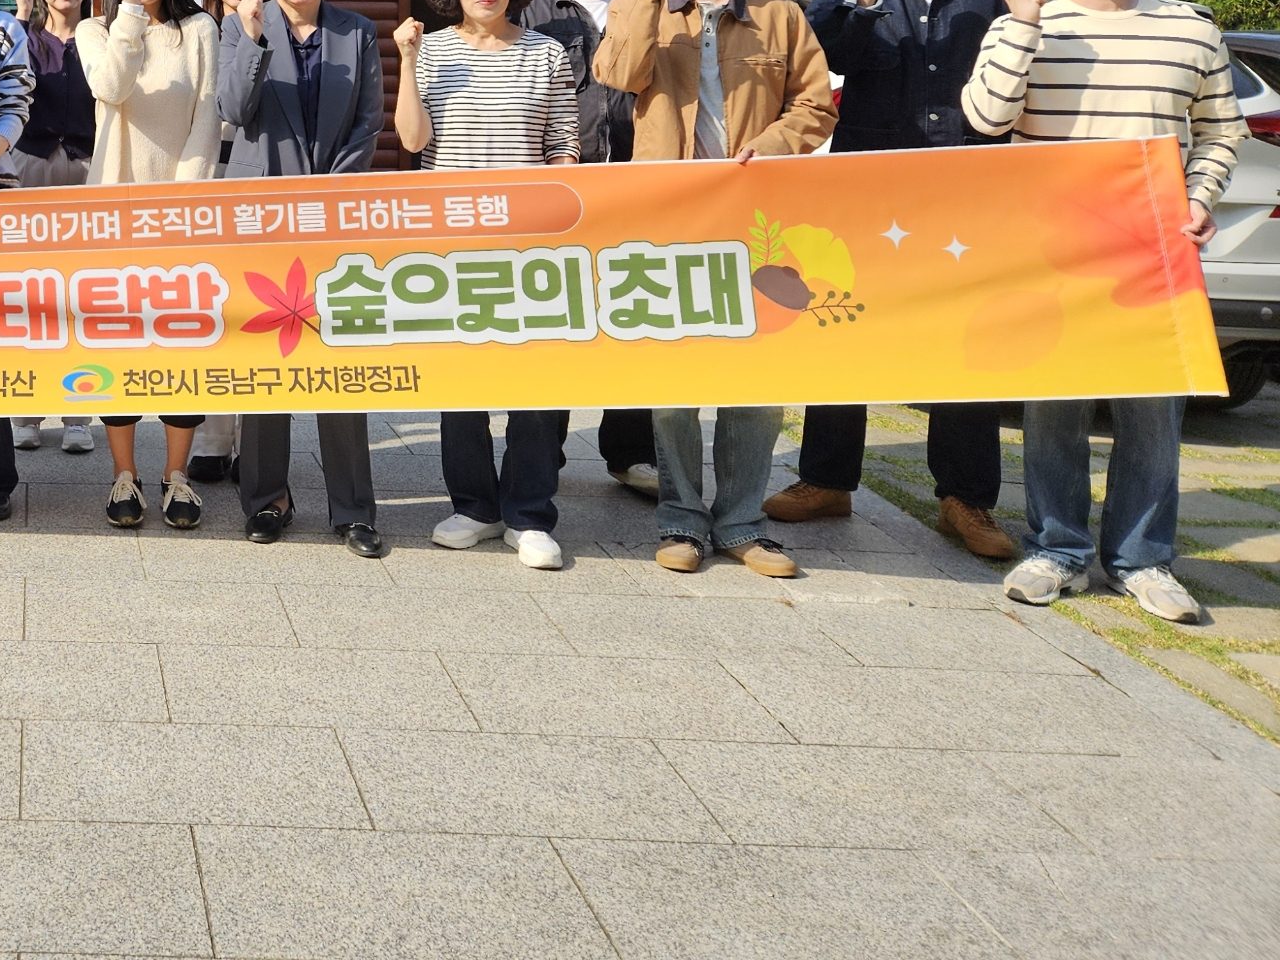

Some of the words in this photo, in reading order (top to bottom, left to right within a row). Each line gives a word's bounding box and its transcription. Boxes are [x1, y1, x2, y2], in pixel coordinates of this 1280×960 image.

[0, 211, 121, 244] 알아가며
[131, 205, 223, 238] 조직의
[233, 201, 327, 235] 활기를
[338, 198, 433, 231] 더하는
[443, 194, 510, 226] 동행
[77, 271, 221, 340] 탐방
[608, 252, 744, 329] 초대
[122, 367, 200, 397] 천안시
[205, 367, 282, 396] 동남구
[287, 364, 421, 394] 자치행정과
